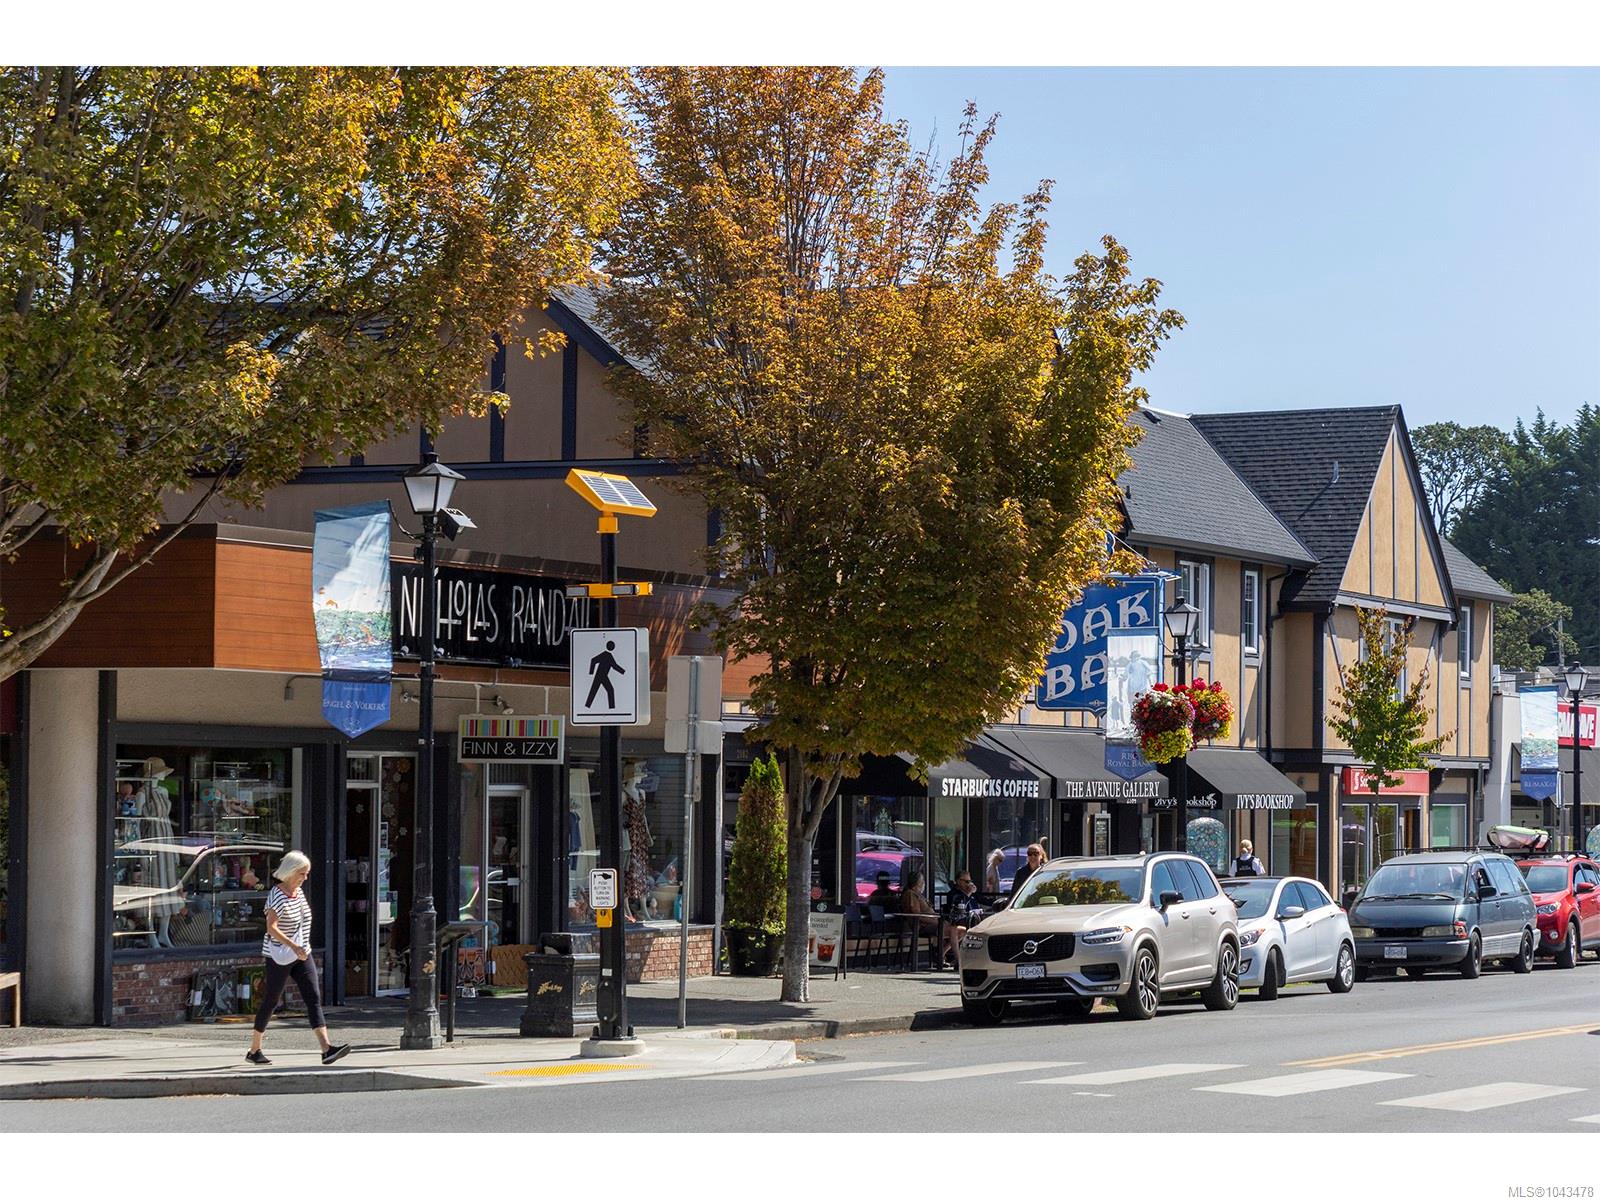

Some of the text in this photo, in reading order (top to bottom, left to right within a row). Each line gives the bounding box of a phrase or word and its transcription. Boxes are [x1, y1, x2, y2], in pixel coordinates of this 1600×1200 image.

[400, 574, 499, 643] NIHOLAS
[1050, 589, 1151, 654] OAK
[1043, 650, 1108, 702] BA
[345, 700, 352, 709] &
[463, 741, 557, 756] FINN & IZZY
[1107, 760, 1130, 768] ROYAL
[941, 778, 1039, 798] STARBUCKS COFFEE
[1065, 781, 1160, 798] THE AVENUE GALLERY
[1236, 794, 1294, 809] IVY'S BOOKSHOP
